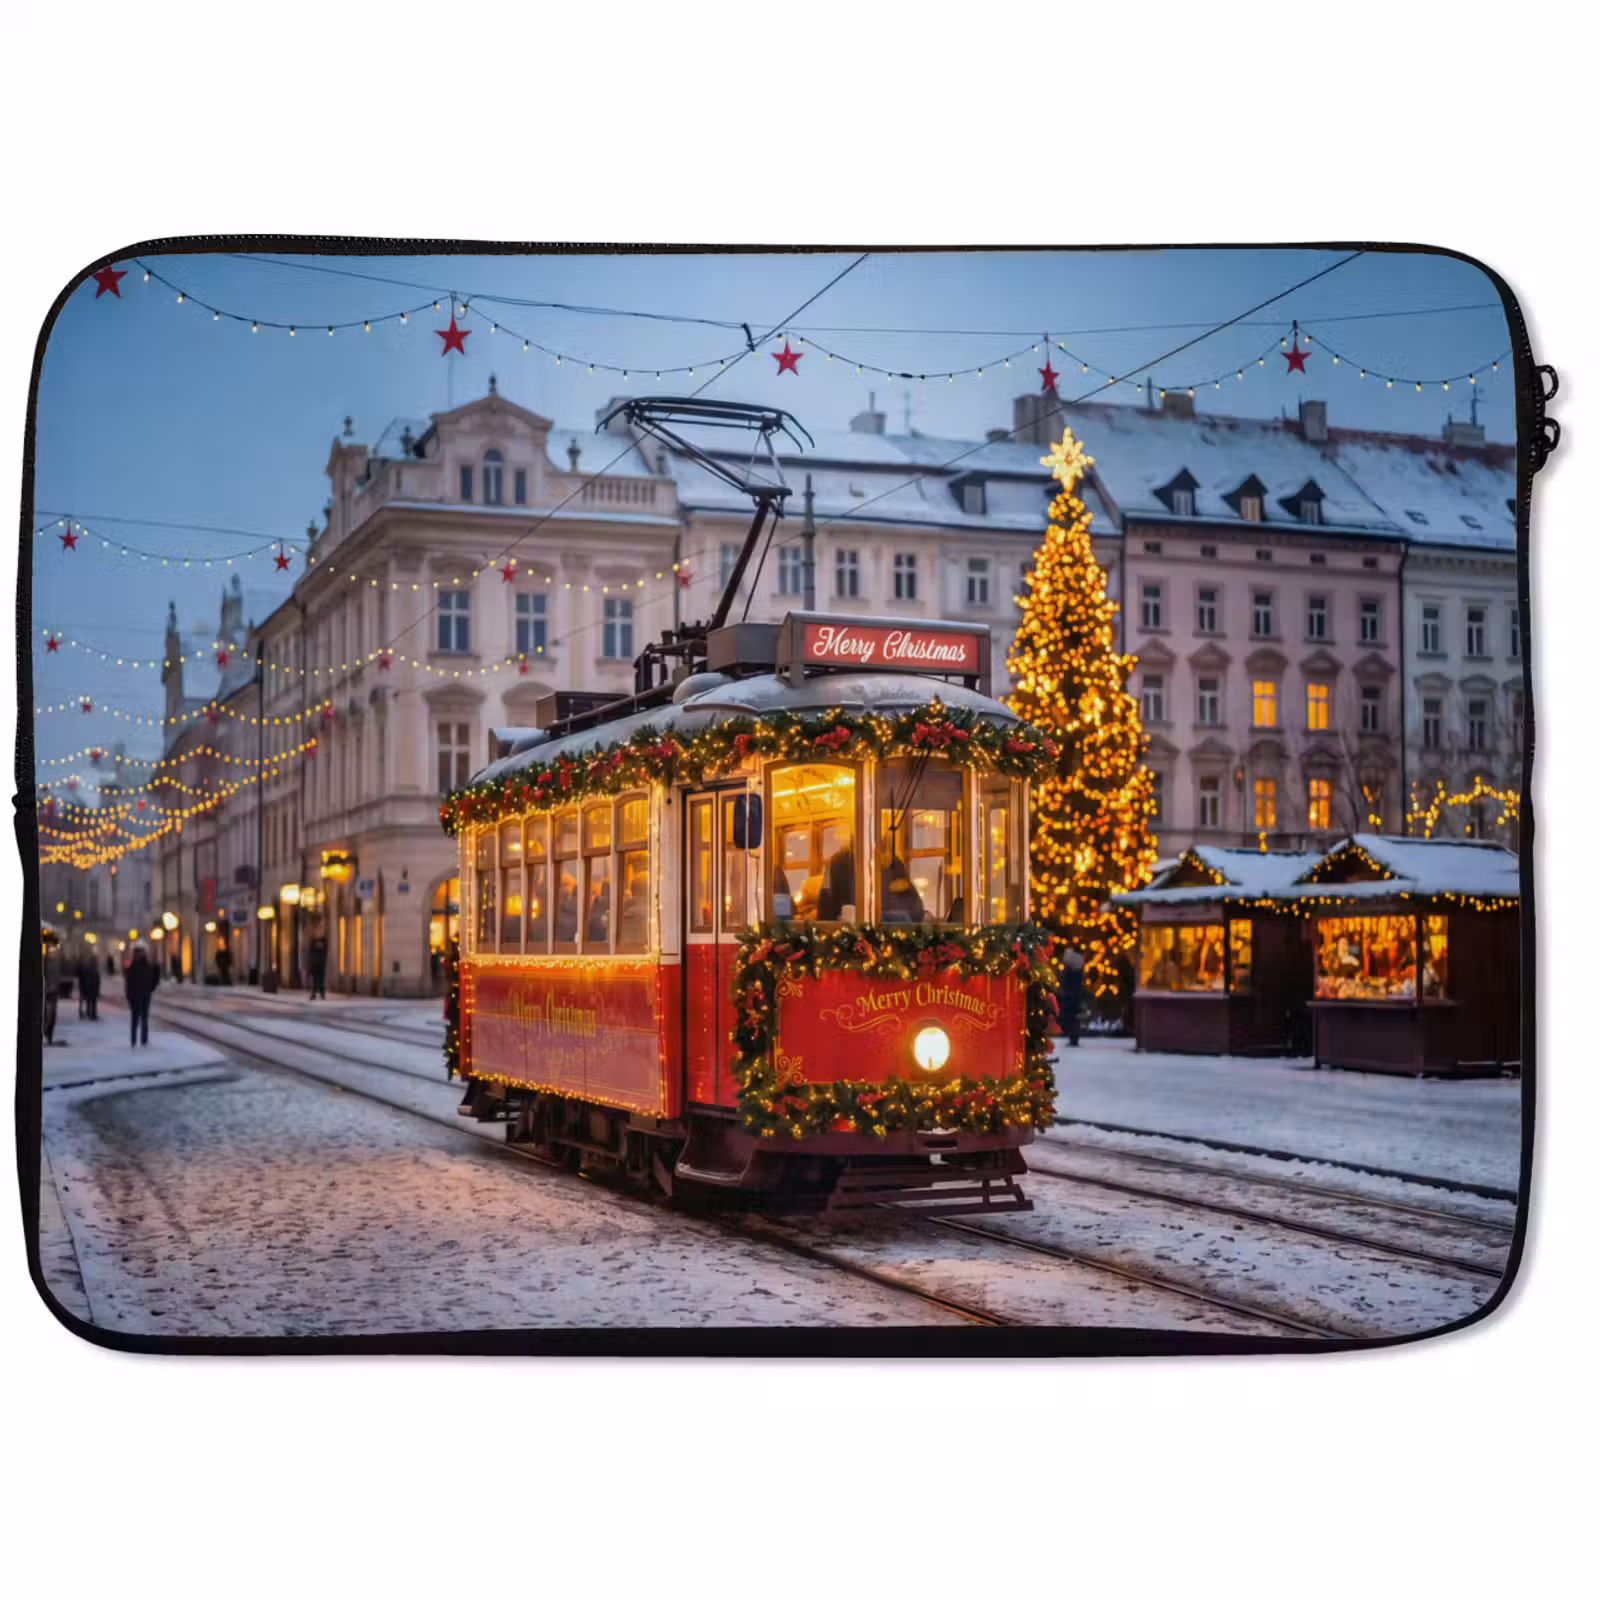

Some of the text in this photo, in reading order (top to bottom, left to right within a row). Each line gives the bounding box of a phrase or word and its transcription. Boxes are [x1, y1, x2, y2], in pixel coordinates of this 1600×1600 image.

[813, 626, 967, 663] Merry Christmas
[856, 982, 986, 1015] Merry Christmas
